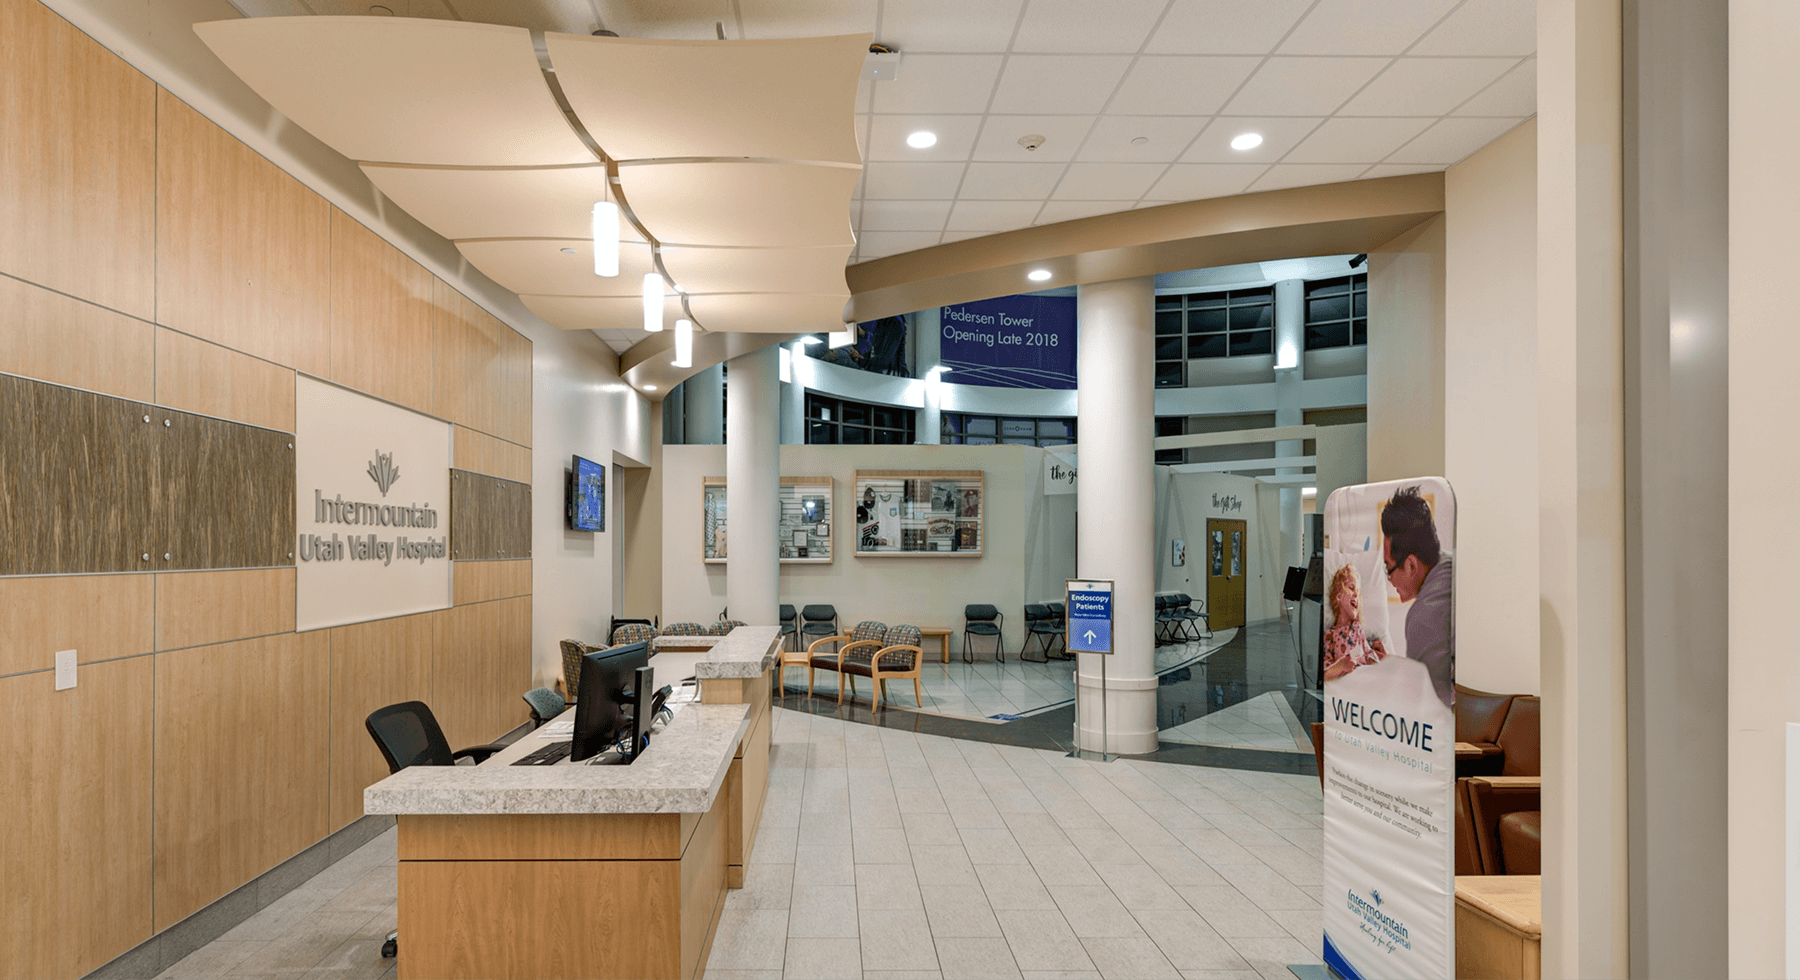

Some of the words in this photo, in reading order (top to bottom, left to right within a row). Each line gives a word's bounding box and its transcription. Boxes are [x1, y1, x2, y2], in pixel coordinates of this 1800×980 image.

[943, 306, 995, 325] Pedersen
[998, 312, 1034, 328] Tower
[943, 325, 995, 347] Opening
[998, 331, 1022, 346] Late
[1025, 332, 1059, 347] 2018
[1050, 464, 1067, 481] the
[1068, 467, 1078, 485] gi
[314, 488, 438, 529] Intermountain
[1211, 492, 1220, 508] the
[1220, 494, 1230, 514] gift
[299, 533, 344, 563] Utah
[347, 534, 394, 567] Valley
[396, 536, 447, 565] Hospital
[1071, 594, 1110, 604] Endoscopy
[1075, 602, 1105, 611] Patients
[1332, 696, 1433, 753] WELCOME
[1334, 730, 1343, 740] to
[1344, 734, 1362, 748] Utah
[1365, 741, 1390, 761] Valley
[1393, 751, 1433, 774] Hospital
[1353, 800, 1365, 810] serve
[1373, 810, 1383, 819] and
[1394, 795, 1409, 807] while
[1393, 804, 1402, 816] We
[1410, 815, 1432, 833] working
[1347, 888, 1409, 940] Intermountain
[1347, 900, 1362, 917] Utah
[1362, 911, 1382, 932] Valley
[1383, 925, 1412, 951] Hospital
